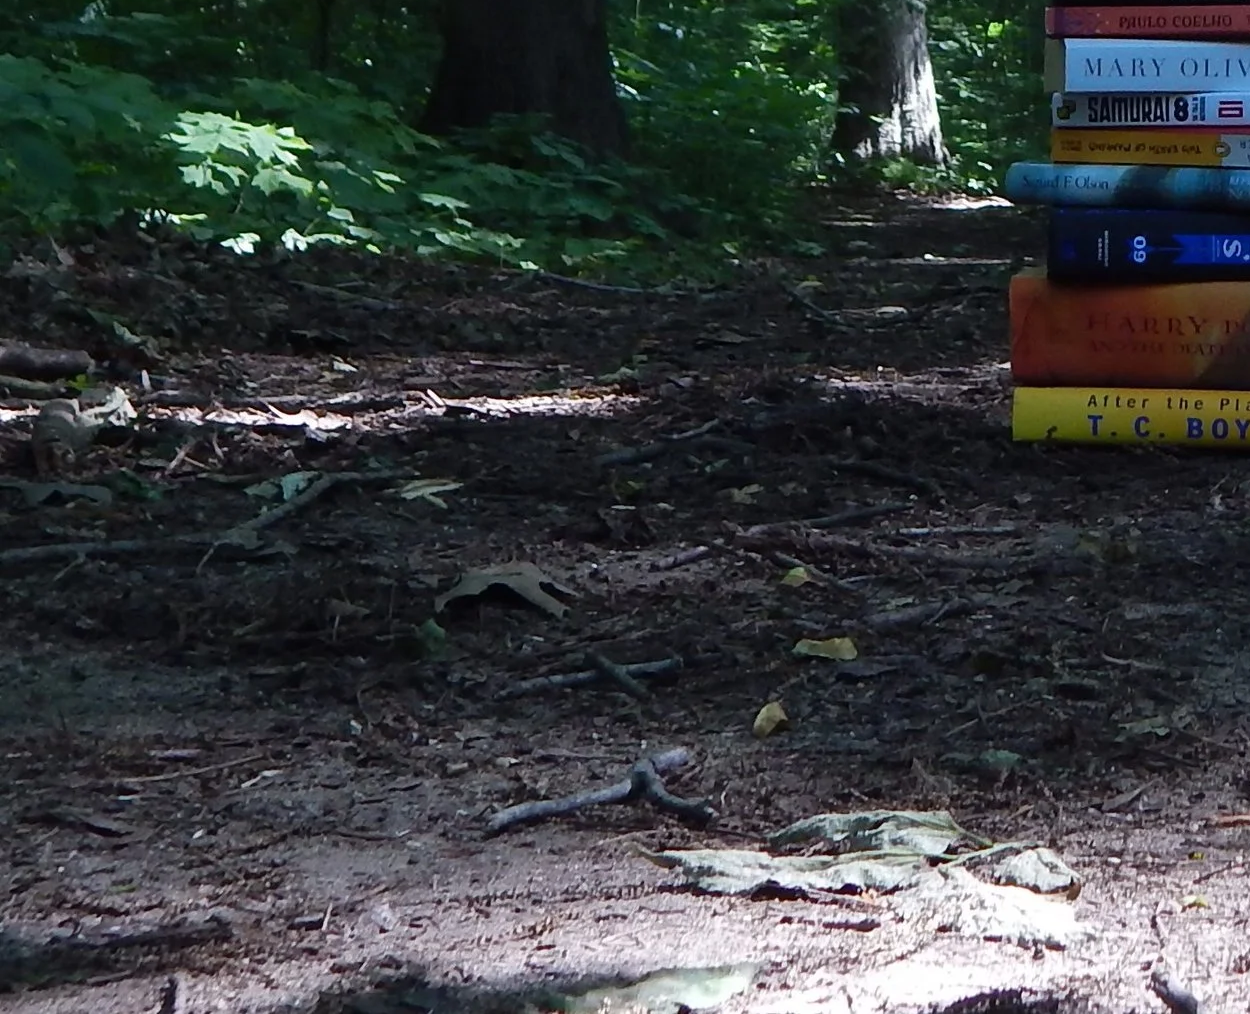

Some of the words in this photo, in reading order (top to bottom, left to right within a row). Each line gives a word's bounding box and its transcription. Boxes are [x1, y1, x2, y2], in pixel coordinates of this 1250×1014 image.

[1119, 15, 1167, 29] PAULO
[1172, 14, 1233, 28] COELHO
[1084, 57, 1166, 78] MARY
[1088, 96, 1170, 123] SAMURAI
[1173, 96, 1189, 122] 8
[1075, 174, 1110, 190] Olson
[1085, 312, 1208, 336] HARRY
[1087, 394, 1150, 409] After
[1167, 396, 1204, 410] the
[1087, 415, 1118, 437] T.
[1135, 416, 1165, 438] C.
